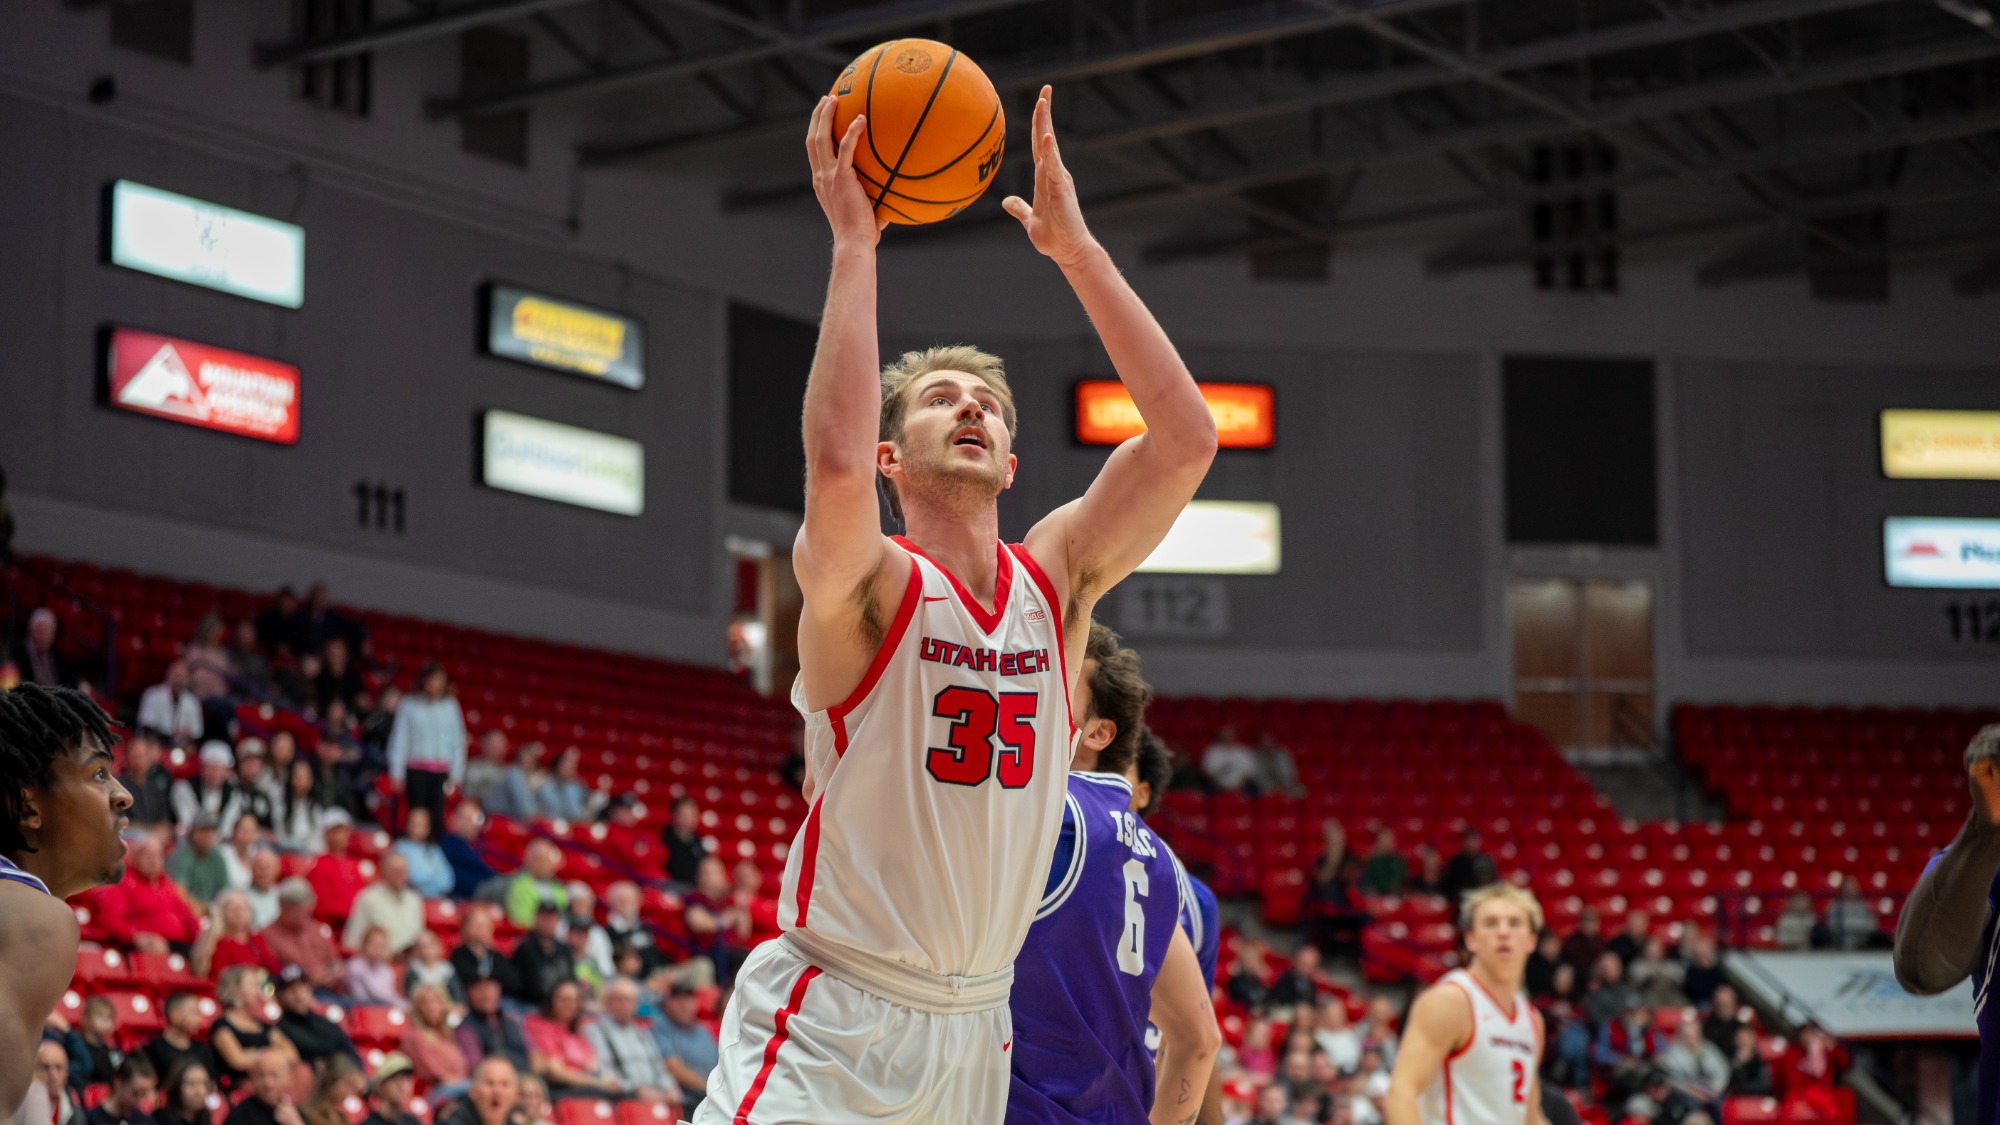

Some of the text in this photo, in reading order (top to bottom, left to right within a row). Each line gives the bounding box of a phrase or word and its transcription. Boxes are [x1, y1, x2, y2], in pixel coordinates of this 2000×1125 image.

[920, 637, 1050, 676] UTAH ECH
[925, 684, 1039, 789] 35
[1116, 858, 1149, 977] 6
[1510, 1059, 1527, 1104] 2
